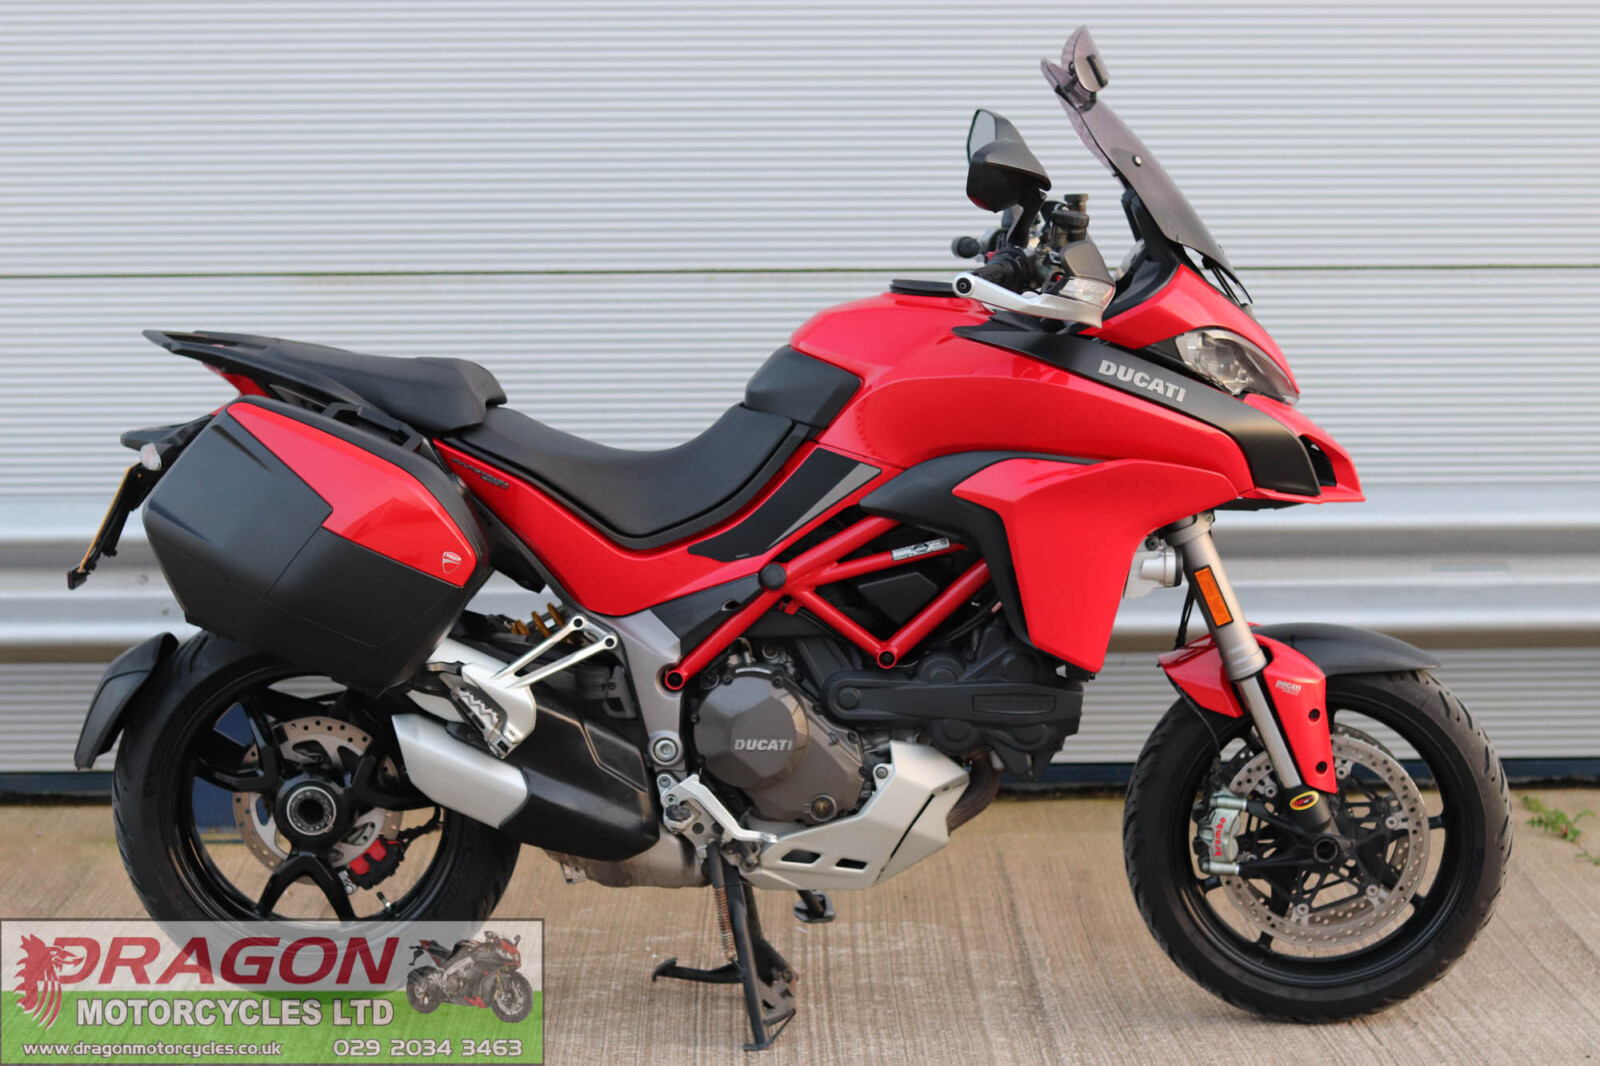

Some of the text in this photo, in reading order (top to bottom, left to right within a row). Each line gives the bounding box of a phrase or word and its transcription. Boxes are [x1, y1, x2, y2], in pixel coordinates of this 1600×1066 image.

[1098, 359, 1187, 402] DUCATI
[734, 738, 793, 751] DUCATI
[1213, 816, 1227, 857] brembo
